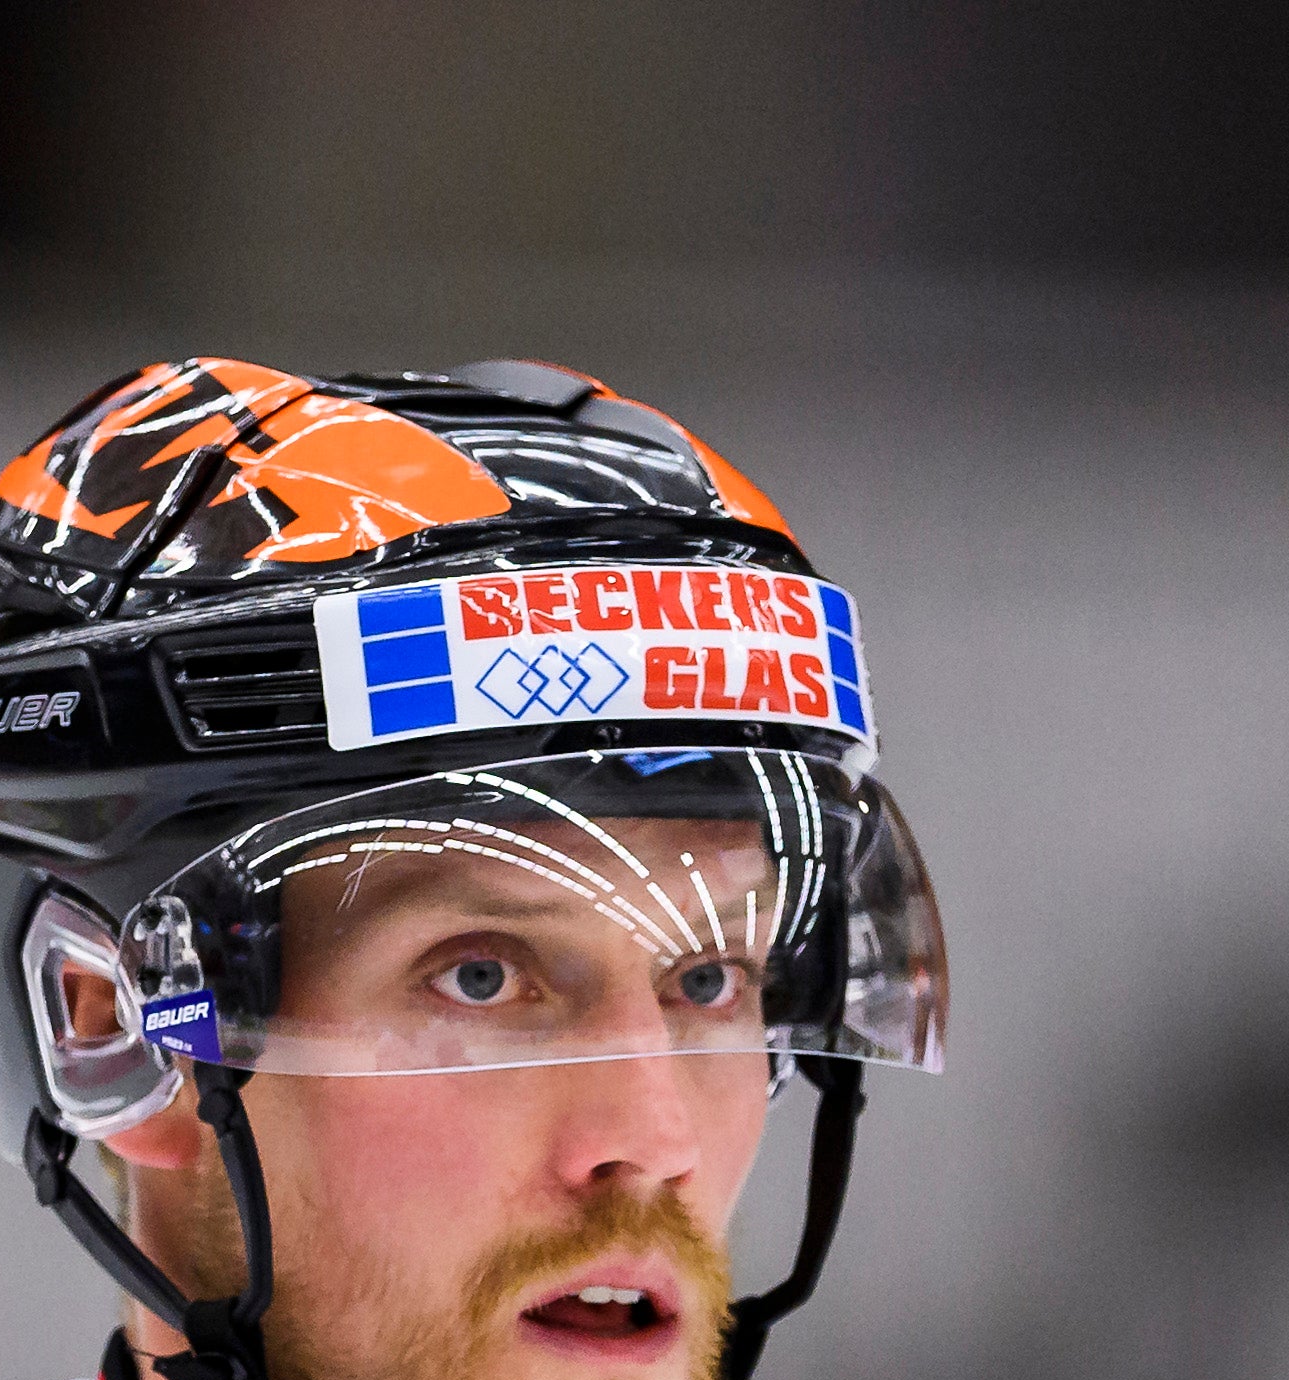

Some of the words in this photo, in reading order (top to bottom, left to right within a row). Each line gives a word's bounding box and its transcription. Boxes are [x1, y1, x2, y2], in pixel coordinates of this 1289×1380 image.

[458, 570, 818, 642] BECKERS
[643, 645, 830, 719] GLAS
[145, 1002, 210, 1031] BAUER
